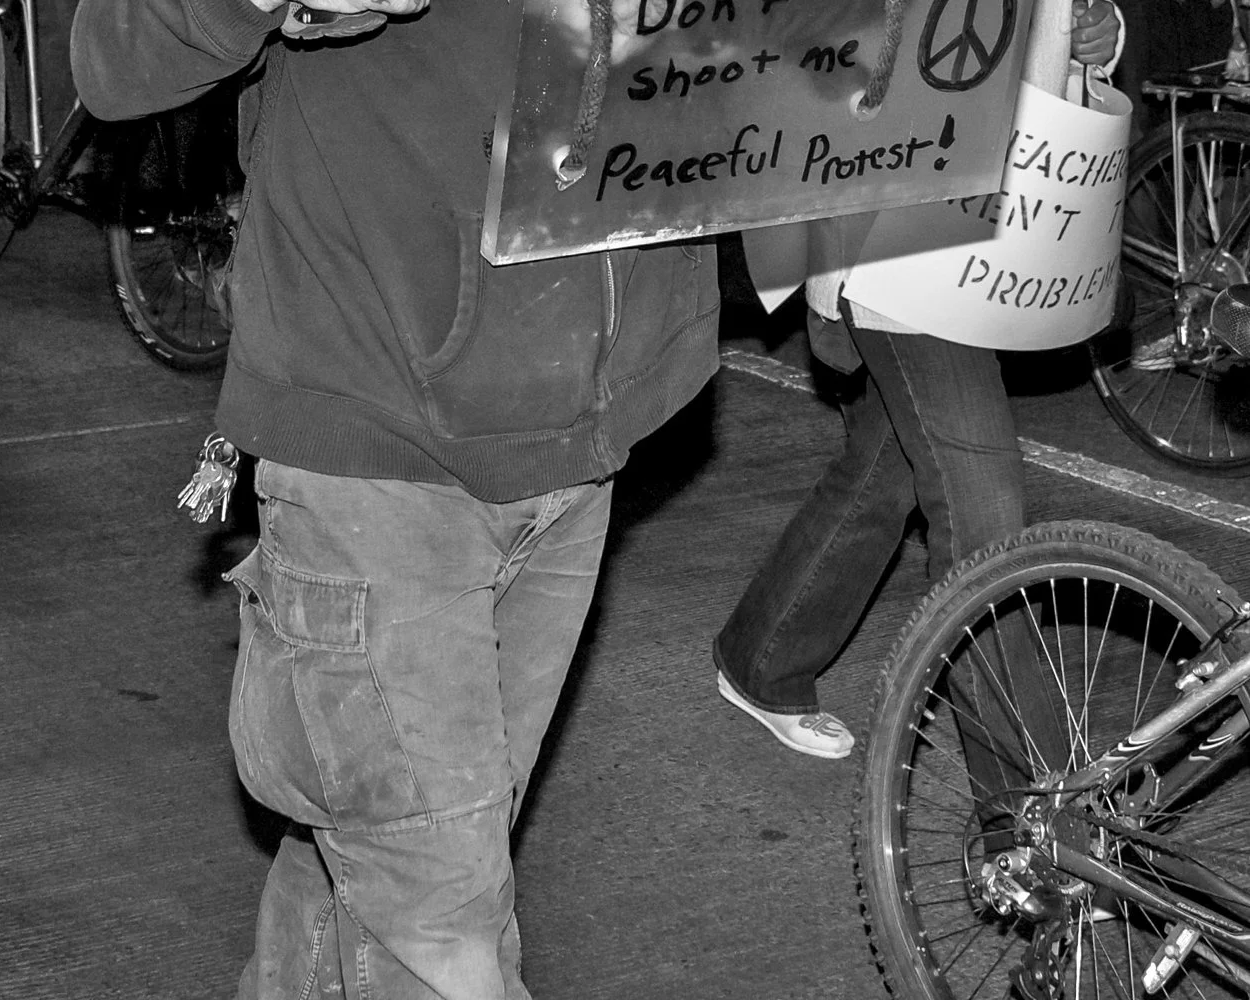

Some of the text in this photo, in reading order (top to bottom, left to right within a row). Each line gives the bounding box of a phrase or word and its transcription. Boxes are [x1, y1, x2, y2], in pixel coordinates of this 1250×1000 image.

[627, 39, 859, 101] shoot me
[596, 114, 956, 201] Peaceful Protest!
